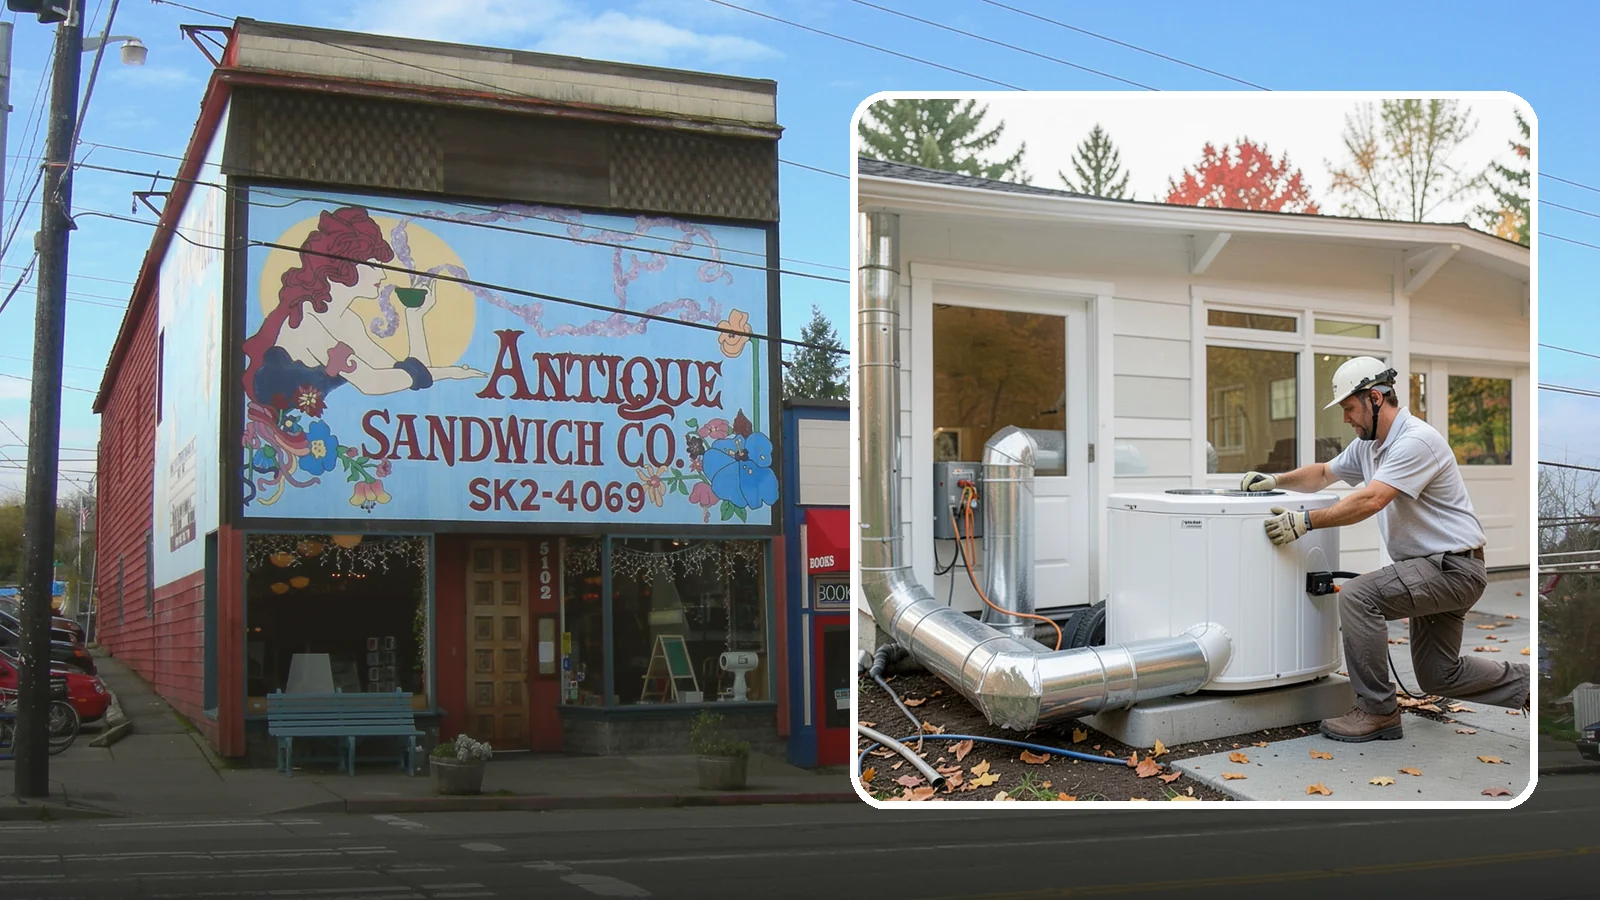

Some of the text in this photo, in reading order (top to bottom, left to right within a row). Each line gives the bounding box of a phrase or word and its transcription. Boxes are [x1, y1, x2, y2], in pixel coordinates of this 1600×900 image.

[475, 329, 724, 421] ANTIQUE
[361, 409, 685, 468] SANDWICH CO.
[469, 477, 646, 513] SK2-4069
[540, 541, 552, 600] 5102
[809, 555, 835, 569] BOOKS
